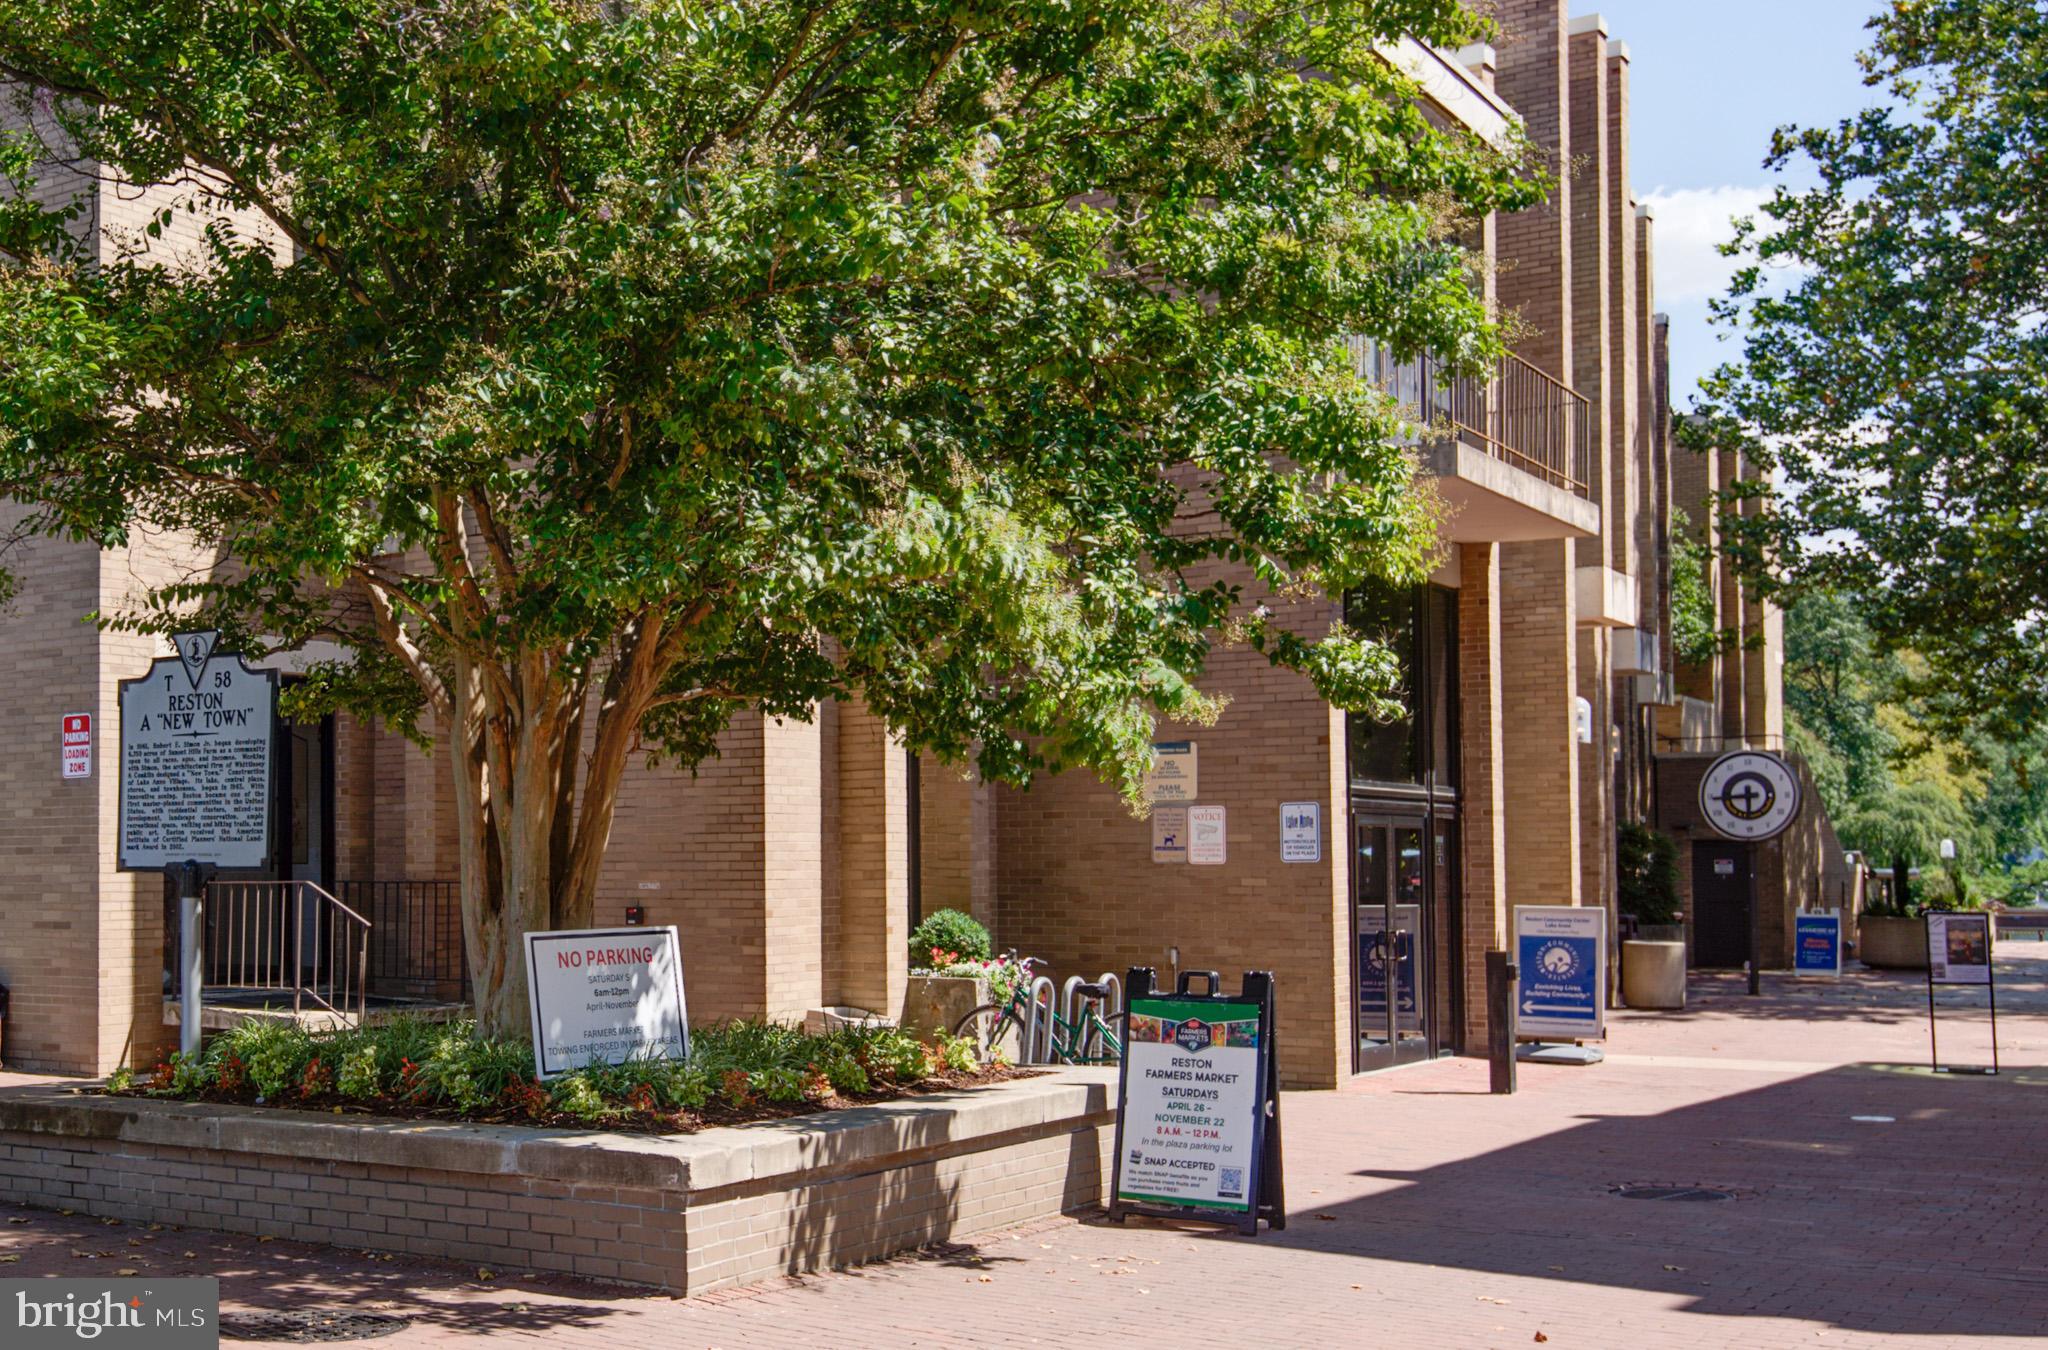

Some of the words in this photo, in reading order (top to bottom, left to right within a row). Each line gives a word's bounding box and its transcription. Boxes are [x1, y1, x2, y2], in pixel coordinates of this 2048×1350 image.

[164, 674, 174, 692] T
[214, 670, 232, 688] 58
[168, 692, 223, 712] RESTON
[72, 719, 81, 730] NO
[140, 714, 150, 731] A
[157, 713, 195, 730] "NEW
[204, 708, 254, 728] TOWN"
[65, 732, 88, 742] PARKING
[64, 748, 88, 759] LOADING
[70, 762, 85, 772] ZONE
[558, 951, 582, 968] NO
[586, 947, 653, 966] PARKING
[594, 988, 630, 997] 6am-12pm
[586, 1000, 640, 1012] April-November
[584, 1028, 617, 1038] FARMERS
[1178, 1034, 1209, 1042] MARKETS
[548, 1046, 578, 1056] TOWING
[580, 1043, 620, 1054] ENFORCED
[1172, 1058, 1212, 1069] RESTON
[1146, 1069, 1193, 1081] FARMERS
[1195, 1072, 1239, 1084] MARKET
[1162, 1086, 1219, 1099] SATURDAYS
[1166, 1102, 1191, 1111] APRIL
[1193, 1104, 1205, 1112] 26
[1155, 1113, 1211, 1126] NOVEMBER
[1214, 1118, 1224, 1126] 22
[1156, 1126, 1162, 1134] 8
[1164, 1127, 1182, 1135] A.M.
[1193, 1129, 1201, 1137] 12
[1203, 1130, 1221, 1139] P.M.
[1142, 1137, 1149, 1145] In
[1166, 1140, 1188, 1148] plaza
[1190, 1142, 1220, 1153] parking
[1144, 1157, 1167, 1166] SNAP
[1169, 1160, 1216, 1171] ACCEPTED
